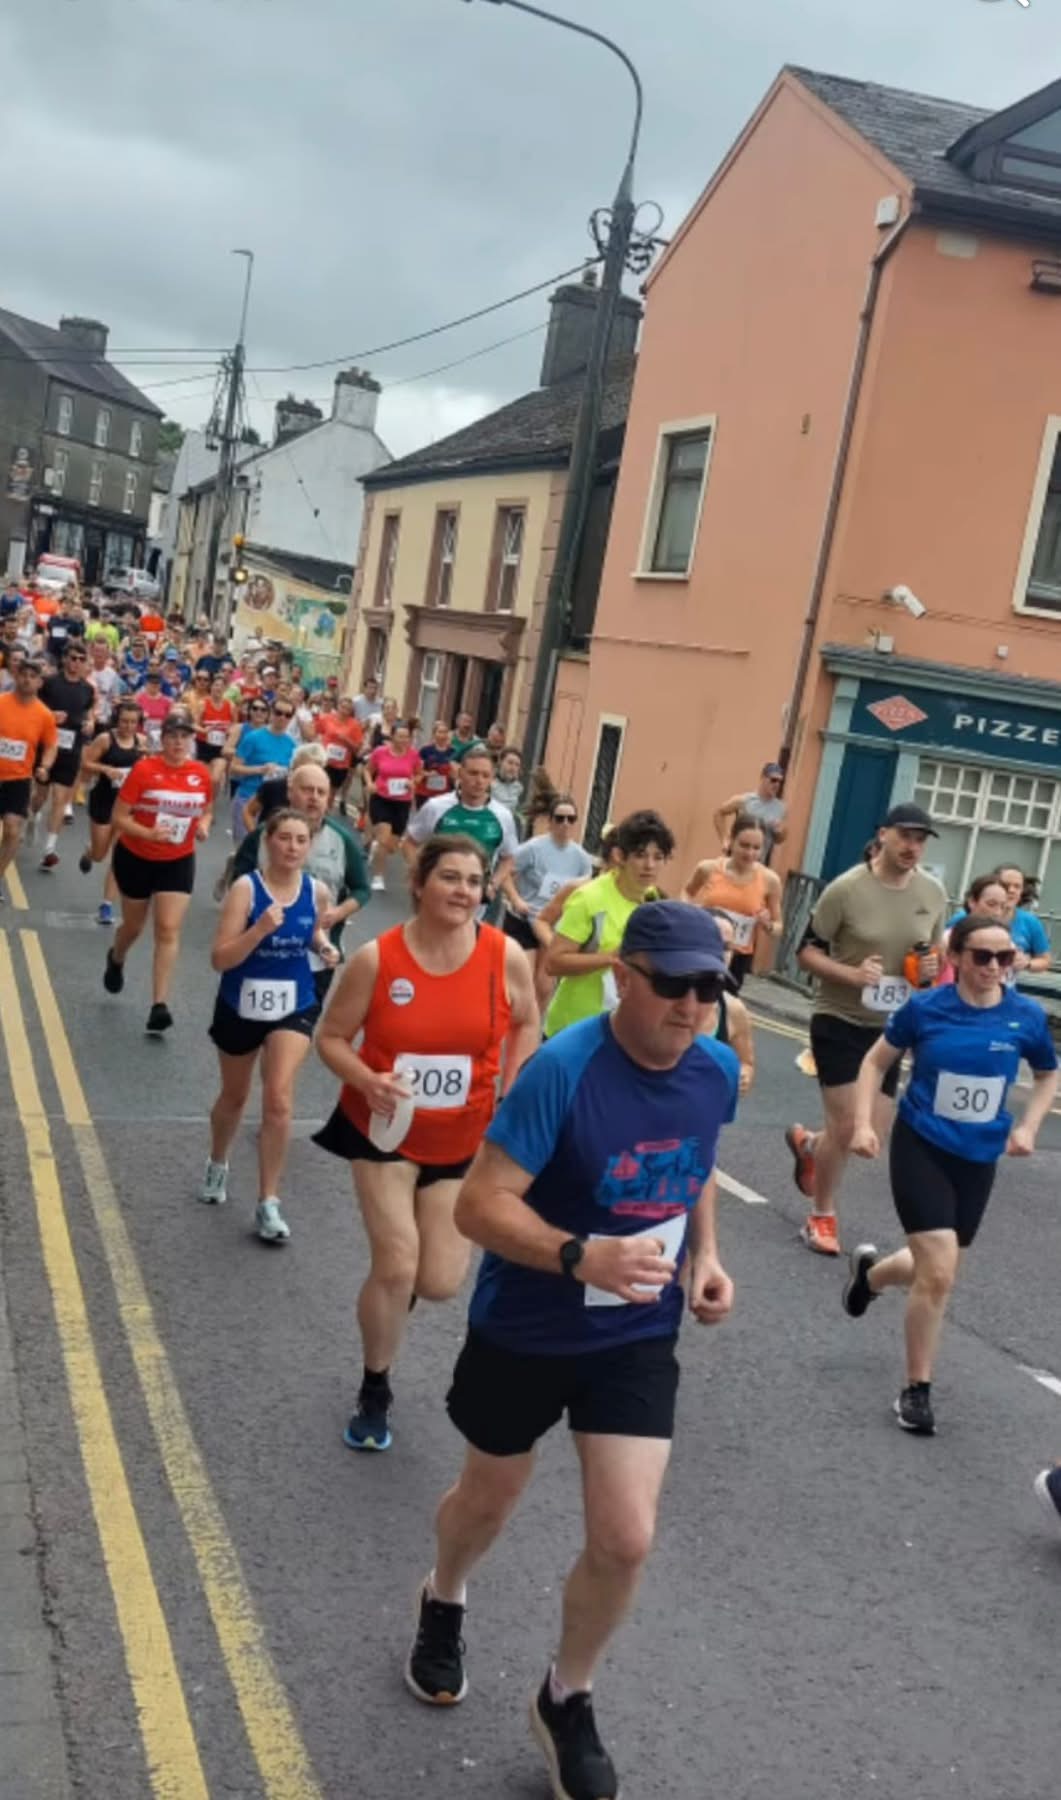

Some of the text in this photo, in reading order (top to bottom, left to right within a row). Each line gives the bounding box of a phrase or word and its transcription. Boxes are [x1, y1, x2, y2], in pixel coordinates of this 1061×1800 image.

[953, 713, 1061, 746] PIZZE
[247, 988, 289, 1012] 181
[951, 1086, 990, 1113] 30
